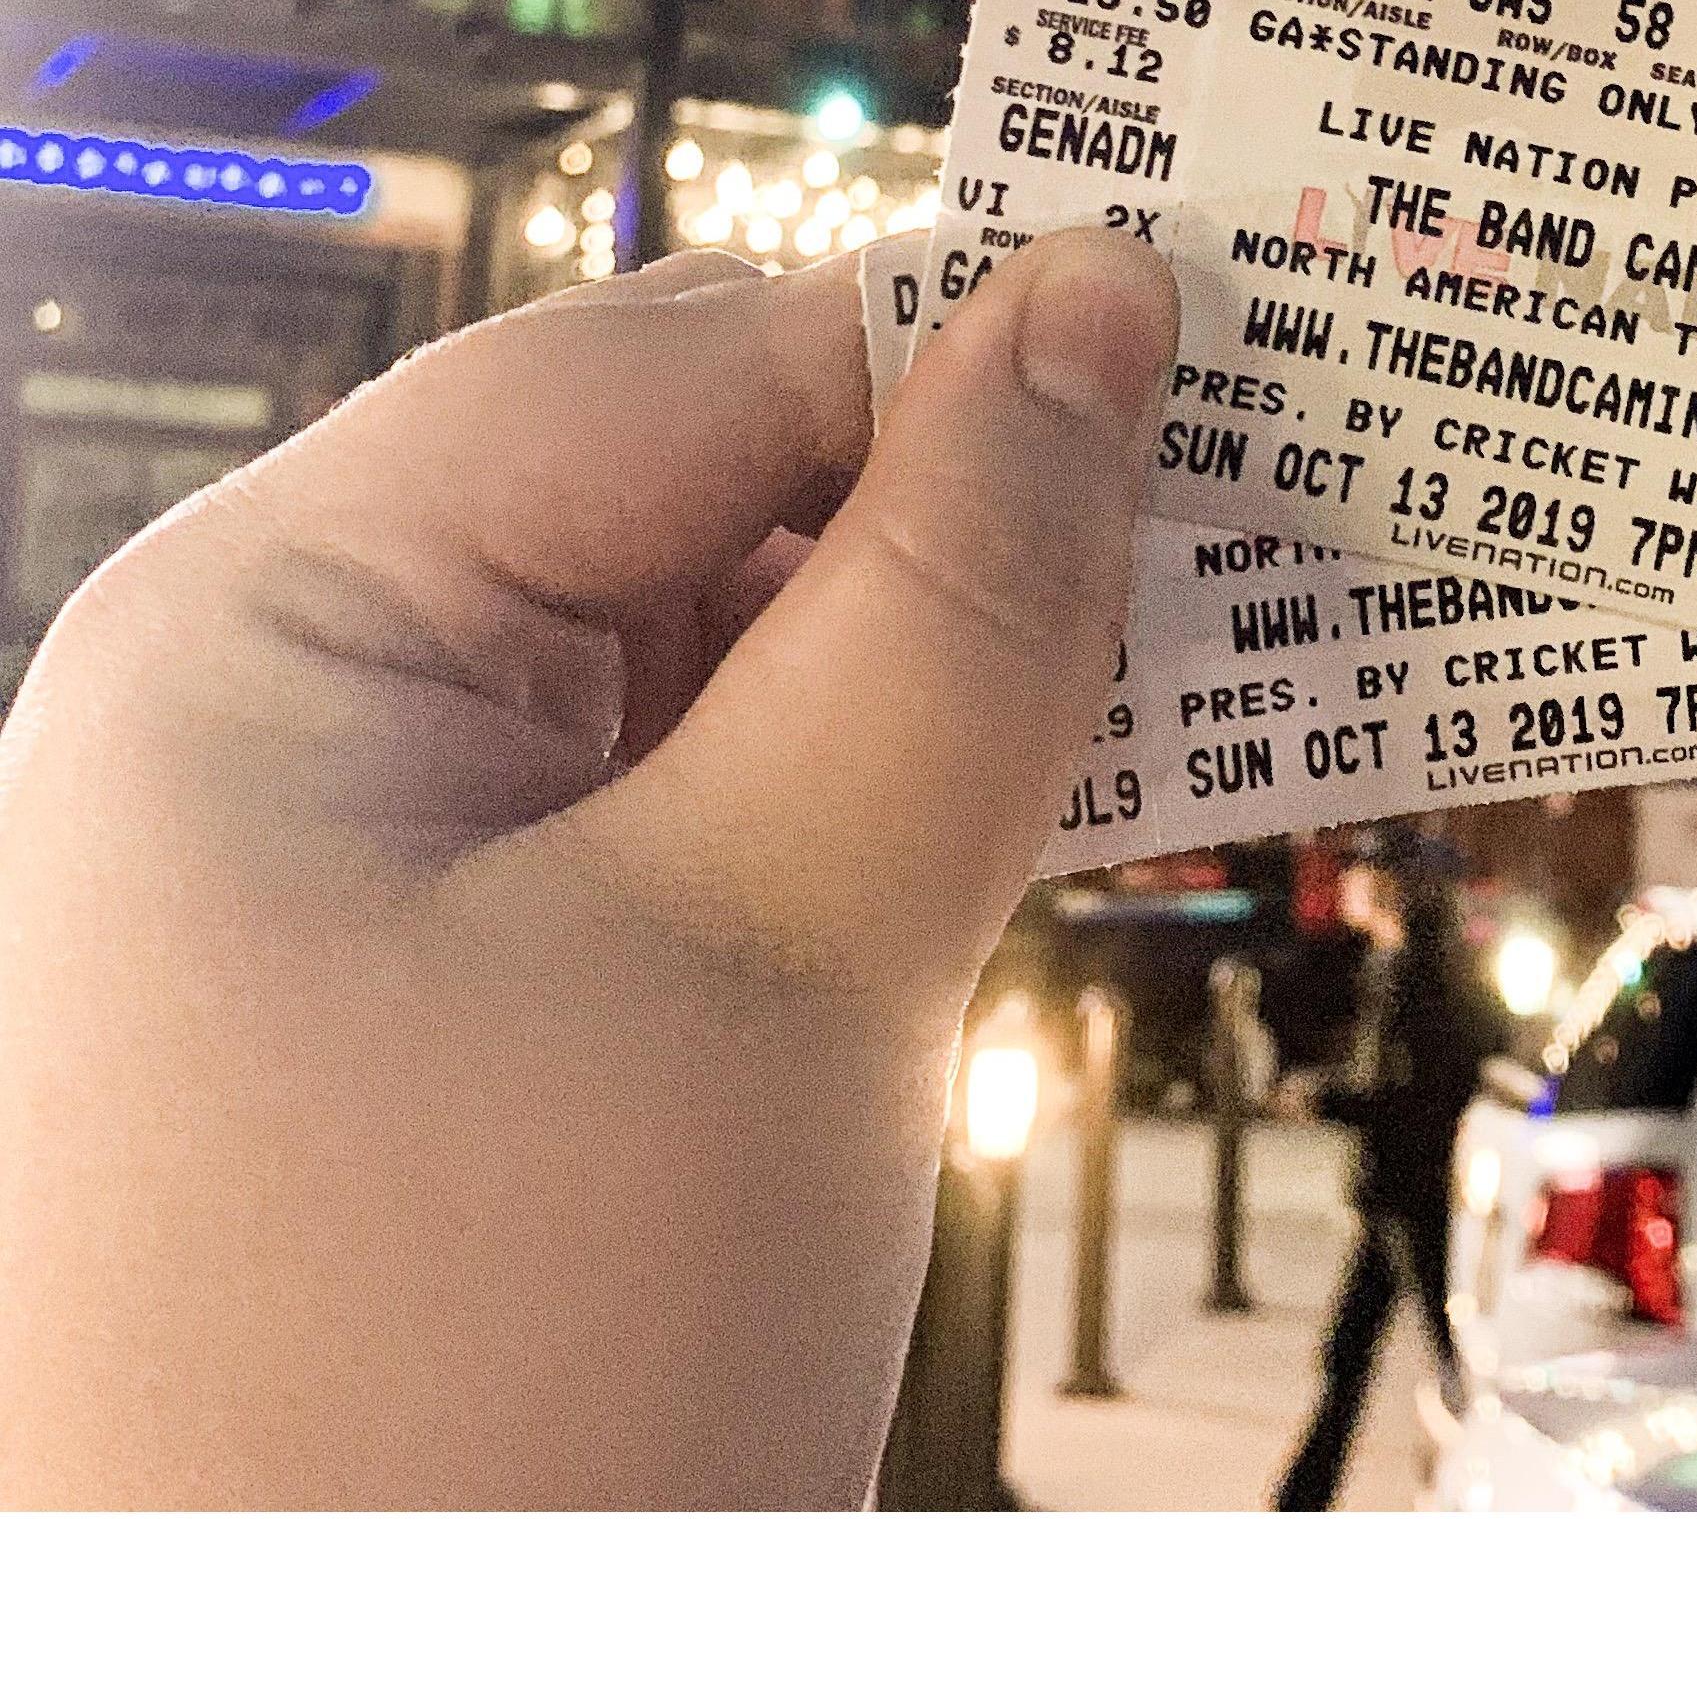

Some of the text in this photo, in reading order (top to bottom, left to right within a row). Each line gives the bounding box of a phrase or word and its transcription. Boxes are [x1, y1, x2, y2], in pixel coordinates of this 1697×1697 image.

[1004, 24, 1163, 83] $ 8.12
[1036, 8, 1150, 48] SERVICE FEE
[1497, 28, 1618, 71] ROW/BOX
[990, 76, 1161, 124] SECTION/AISLE
[1000, 103, 1178, 181] GENADM
[1320, 102, 1437, 154] LIVE
[1464, 131, 1641, 199] NATION
[958, 176, 1009, 217] VI
[1367, 176, 1452, 239] THE
[1475, 200, 1597, 269] BAND
[980, 227, 1034, 251] ROW
[1232, 229, 1375, 289] NORTH
[1405, 267, 1641, 344] AMERICAN
[1170, 364, 1306, 422] PRES.
[1345, 398, 1403, 439] BY
[1433, 418, 1641, 491] CRICKET
[1157, 421, 1249, 482] SUN
[1273, 442, 1366, 504] OCT
[1388, 466, 1449, 521] 13
[1476, 484, 1596, 554] 2019
[1194, 534, 1341, 577] NOR
[1180, 677, 1318, 728] PRES.
[1356, 660, 1409, 700] BY
[1445, 633, 1648, 688] CRICKET
[1187, 737, 1274, 799] SUN
[1304, 719, 1390, 779] OCT
[1424, 709, 1478, 762] 13
[1508, 692, 1625, 752] 2019
